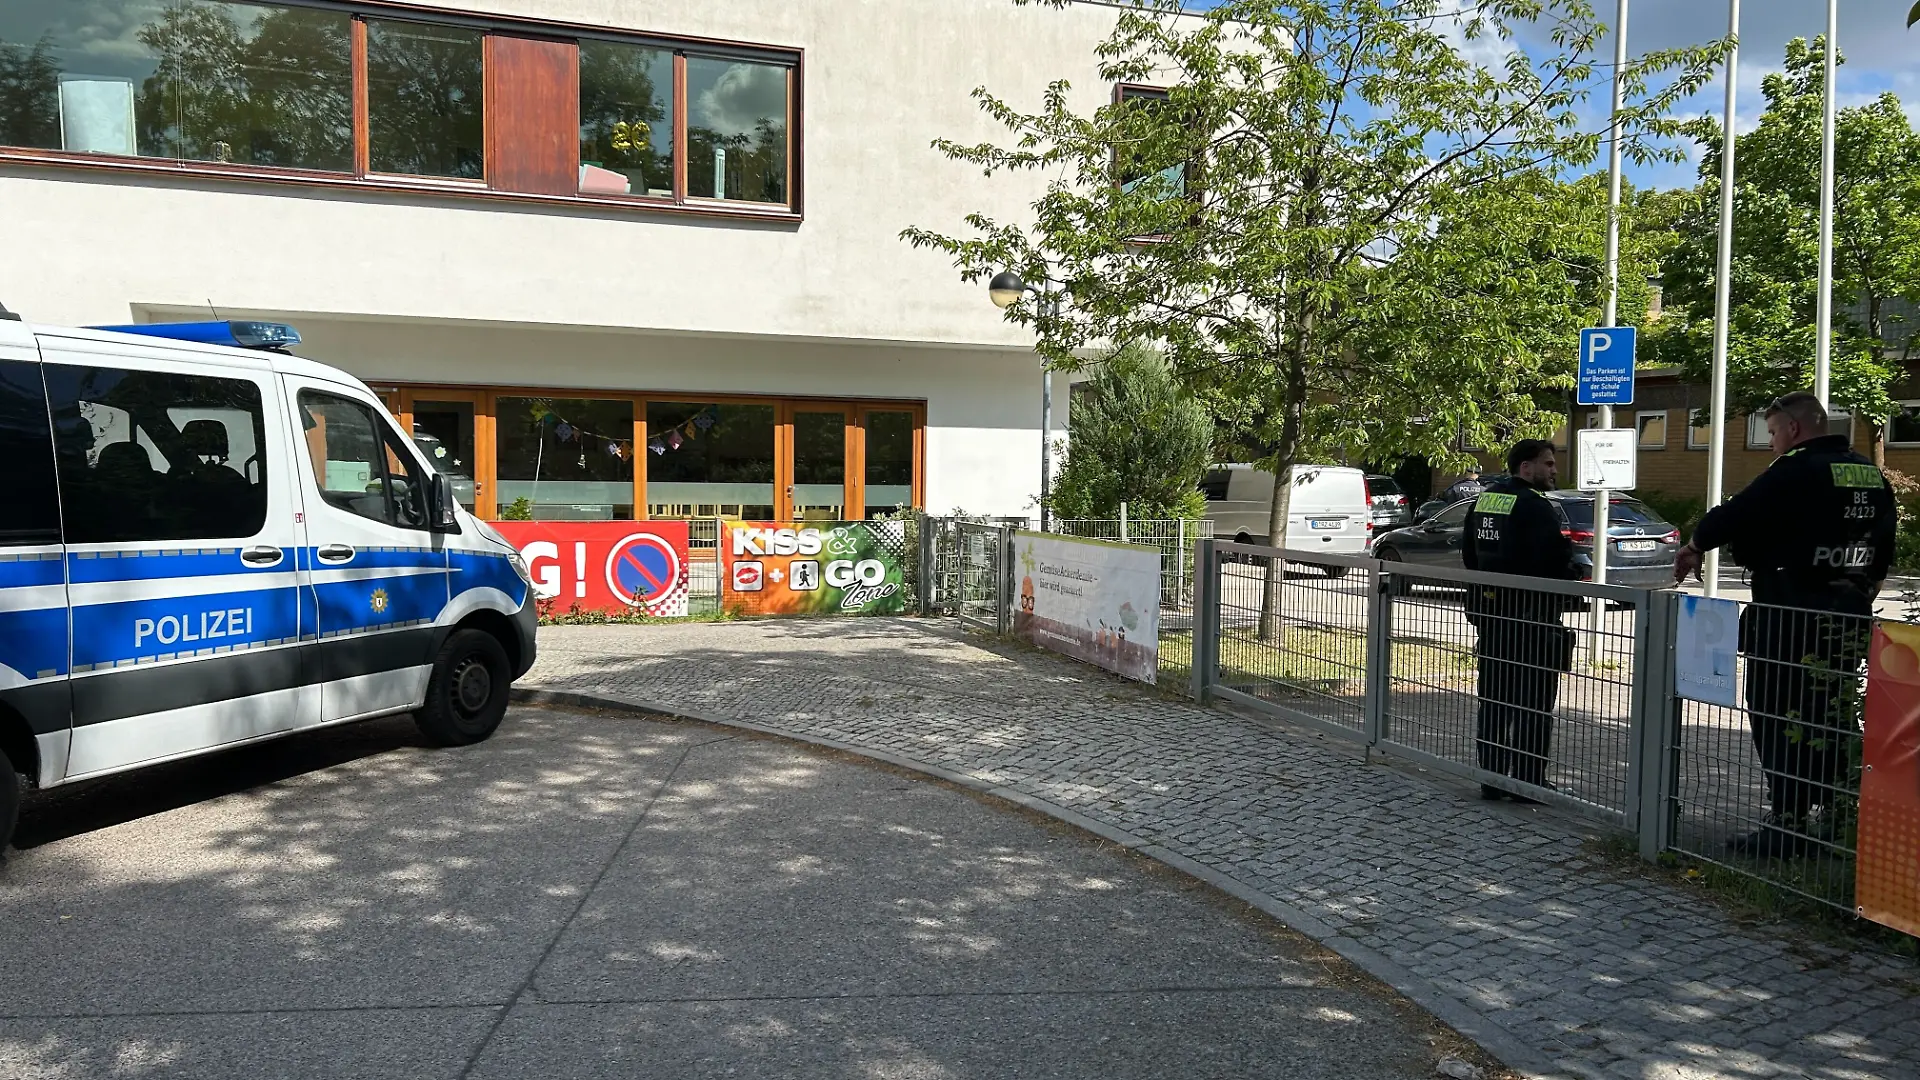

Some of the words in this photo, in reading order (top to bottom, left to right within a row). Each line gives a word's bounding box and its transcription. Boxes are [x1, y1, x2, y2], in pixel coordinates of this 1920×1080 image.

[1588, 333, 1612, 363] P
[1586, 367, 1597, 375] Das
[1597, 367, 1618, 375] Parken
[1601, 382, 1620, 390] Schule
[1853, 491, 1868, 505] BE
[1843, 506, 1876, 519] 24123
[1483, 517, 1494, 528] BE
[732, 528, 823, 556] KISS
[827, 527, 858, 554] &
[1477, 529, 1500, 540] 24124
[825, 559, 886, 589] GO
[840, 578, 900, 609] Zone
[135, 607, 252, 648] POLIZEI
